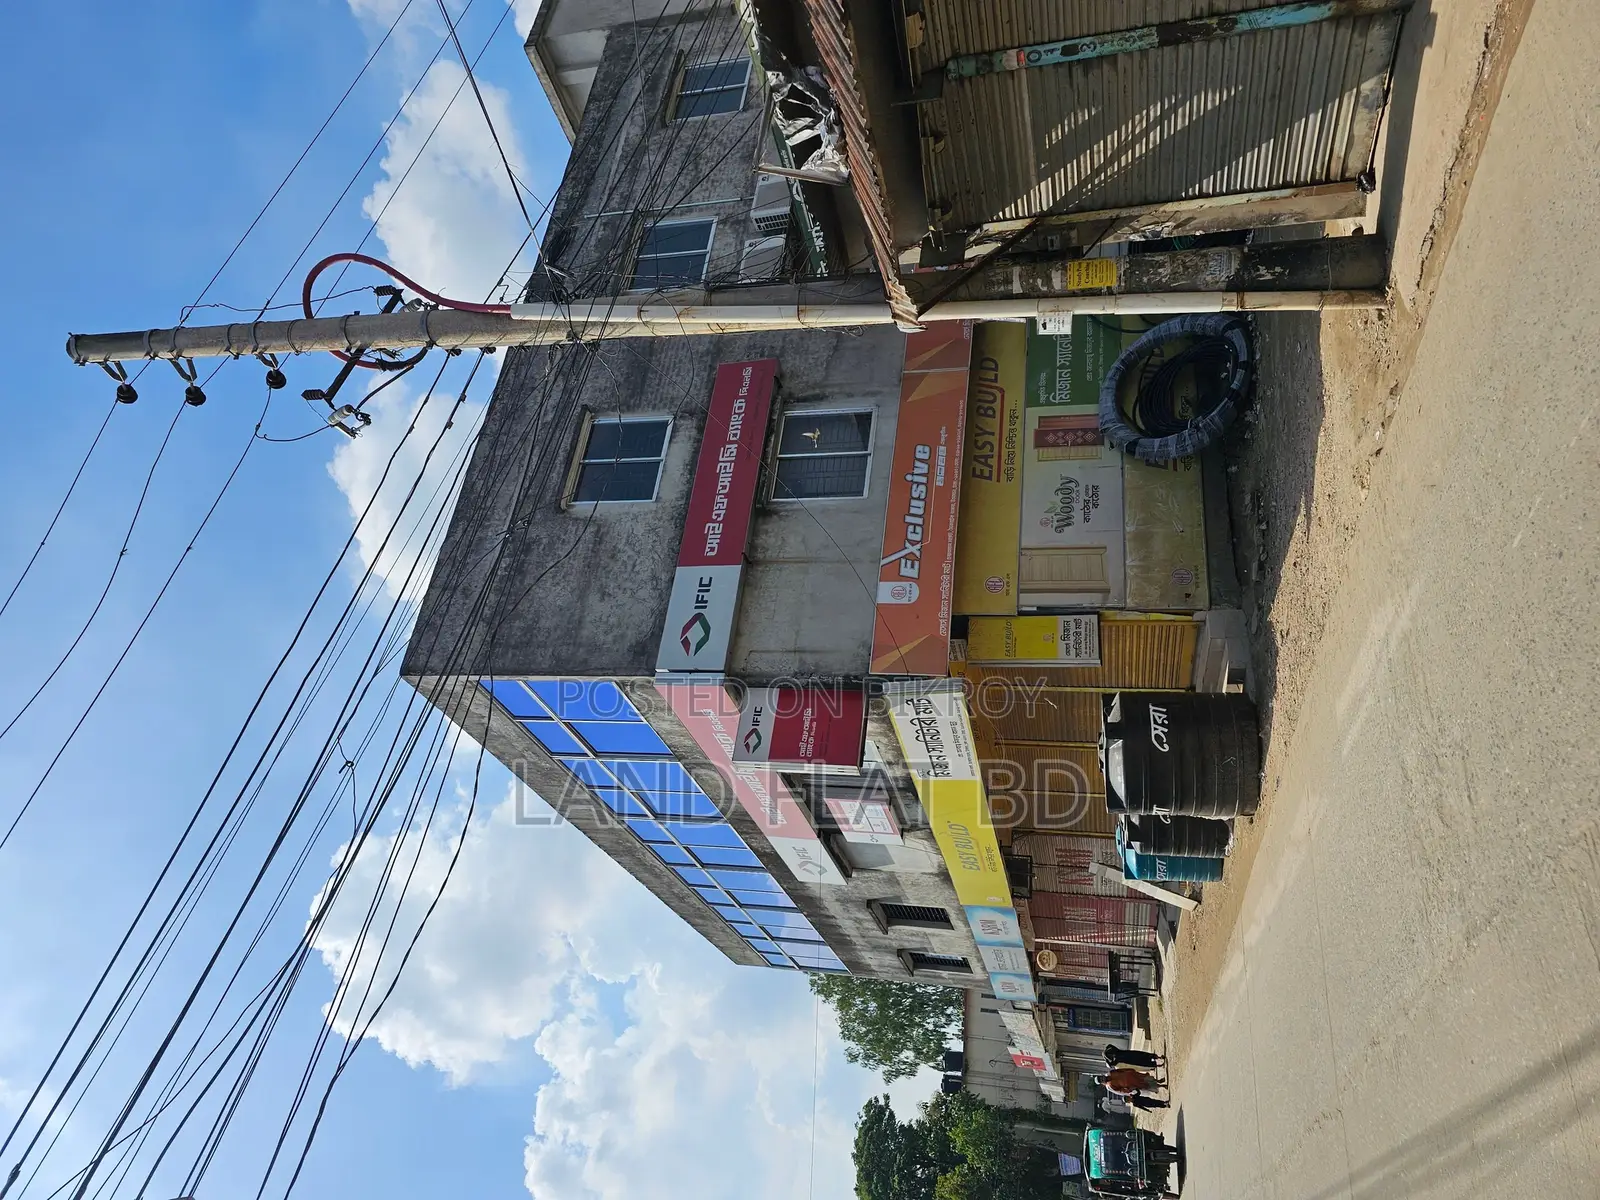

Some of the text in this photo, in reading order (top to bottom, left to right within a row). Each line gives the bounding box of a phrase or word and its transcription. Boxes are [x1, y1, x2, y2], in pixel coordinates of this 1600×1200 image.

[1052, 334, 1072, 368] স্যানেট
[1050, 368, 1072, 403] মিজান
[971, 358, 1001, 482] EASY BUILD
[888, 444, 931, 580] Exclusive
[1054, 476, 1080, 534] Woody
[1080, 499, 1091, 523] কাঠের
[1089, 484, 1100, 509] কঠোর
[694, 576, 713, 610] IFIC
[1004, 620, 1012, 658] EASY BUILD
[1060, 620, 1071, 641] মিজান
[752, 706, 762, 727] IFIC
[1149, 703, 1170, 752] সেরা
[906, 698, 952, 777] মিজান স্যানিটারী মার্ট
[948, 824, 980, 872] EASY BUILD
